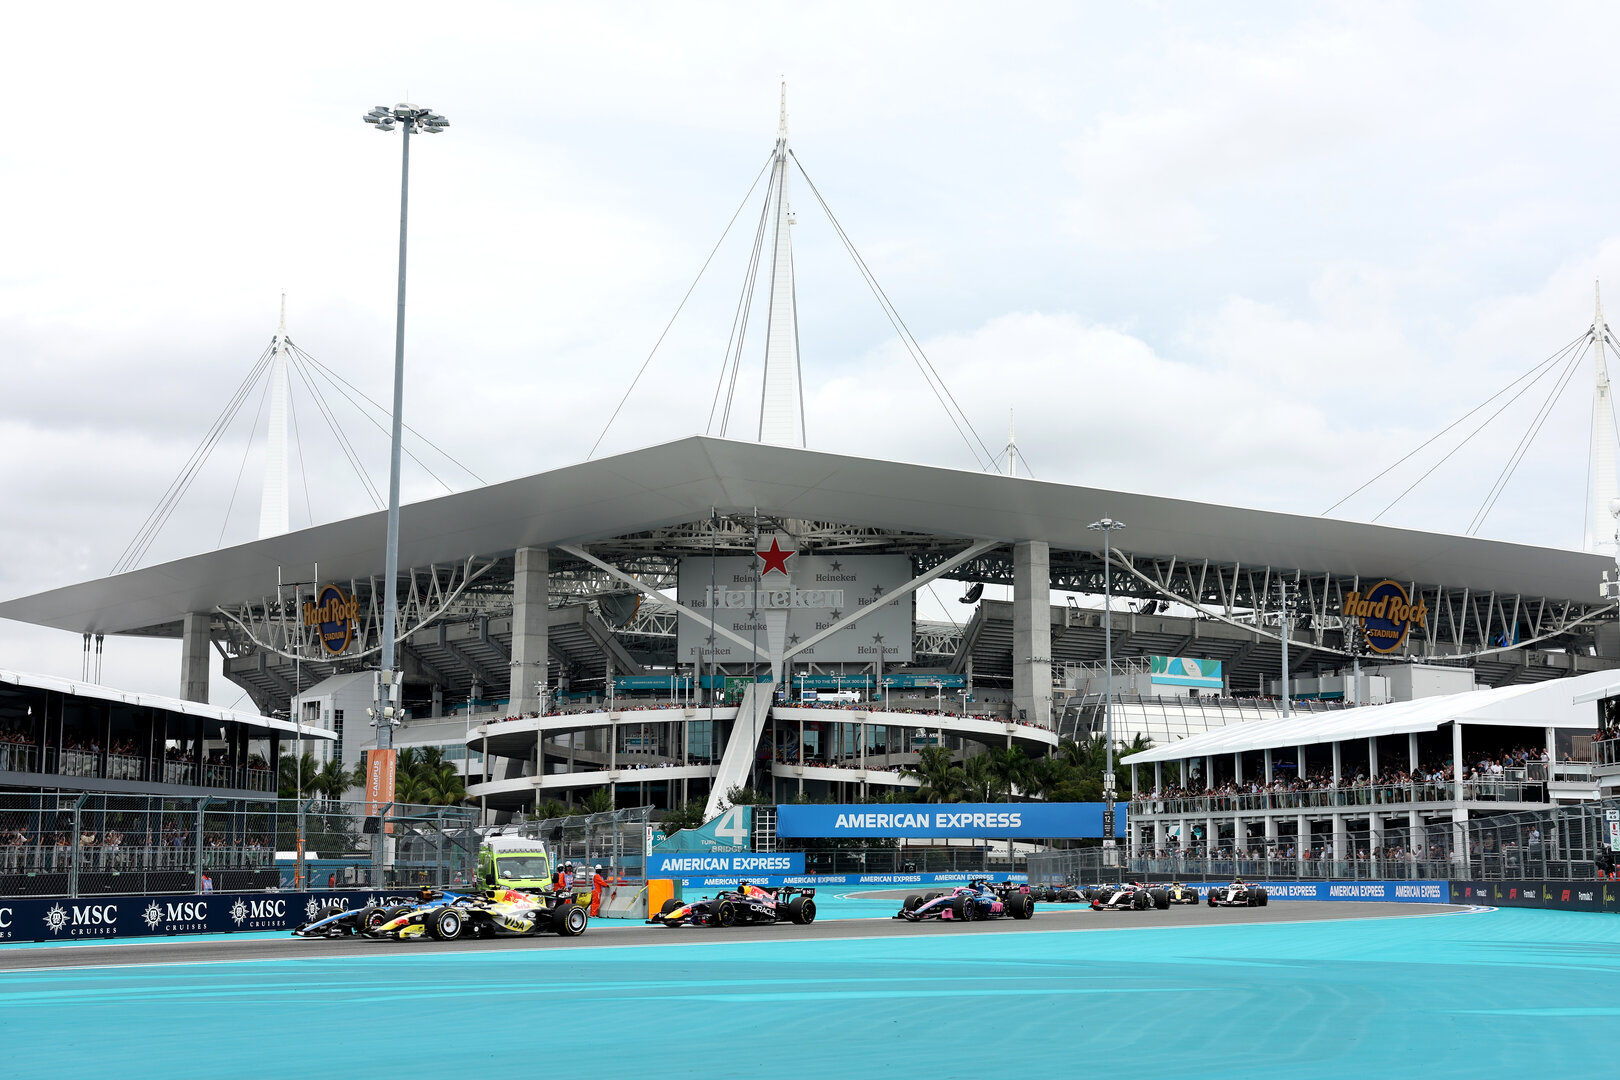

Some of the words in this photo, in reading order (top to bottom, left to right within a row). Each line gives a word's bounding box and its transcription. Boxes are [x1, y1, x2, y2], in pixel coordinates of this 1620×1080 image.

[706, 585, 840, 608] Heineken
[304, 600, 330, 626] Hard
[330, 595, 360, 626] Rock
[1344, 592, 1388, 618] Hard
[1387, 596, 1428, 628] Rock
[1368, 628, 1399, 639] STADIUM
[858, 646, 898, 654] Heinken
[714, 806, 748, 845] 4
[835, 814, 930, 828] AMERICAN
[936, 813, 1022, 828] EXPRESS
[660, 858, 729, 872] AMERICAN
[732, 857, 790, 870] EXPRESS
[1288, 886, 1316, 896] EXPRESS
[1330, 886, 1359, 896] AMERICAN
[1360, 886, 1384, 896] EXPRESS
[1395, 886, 1420, 897] AMERICAN
[1421, 886, 1440, 898] EXPRESS
[166, 902, 208, 922] MSC
[250, 900, 286, 918] MSC
[321, 898, 349, 912] MSC
[750, 904, 776, 918] ORACLE
[72, 905, 118, 926] MSC
[504, 916, 524, 930] VISA
[71, 928, 117, 936] CRUISES
